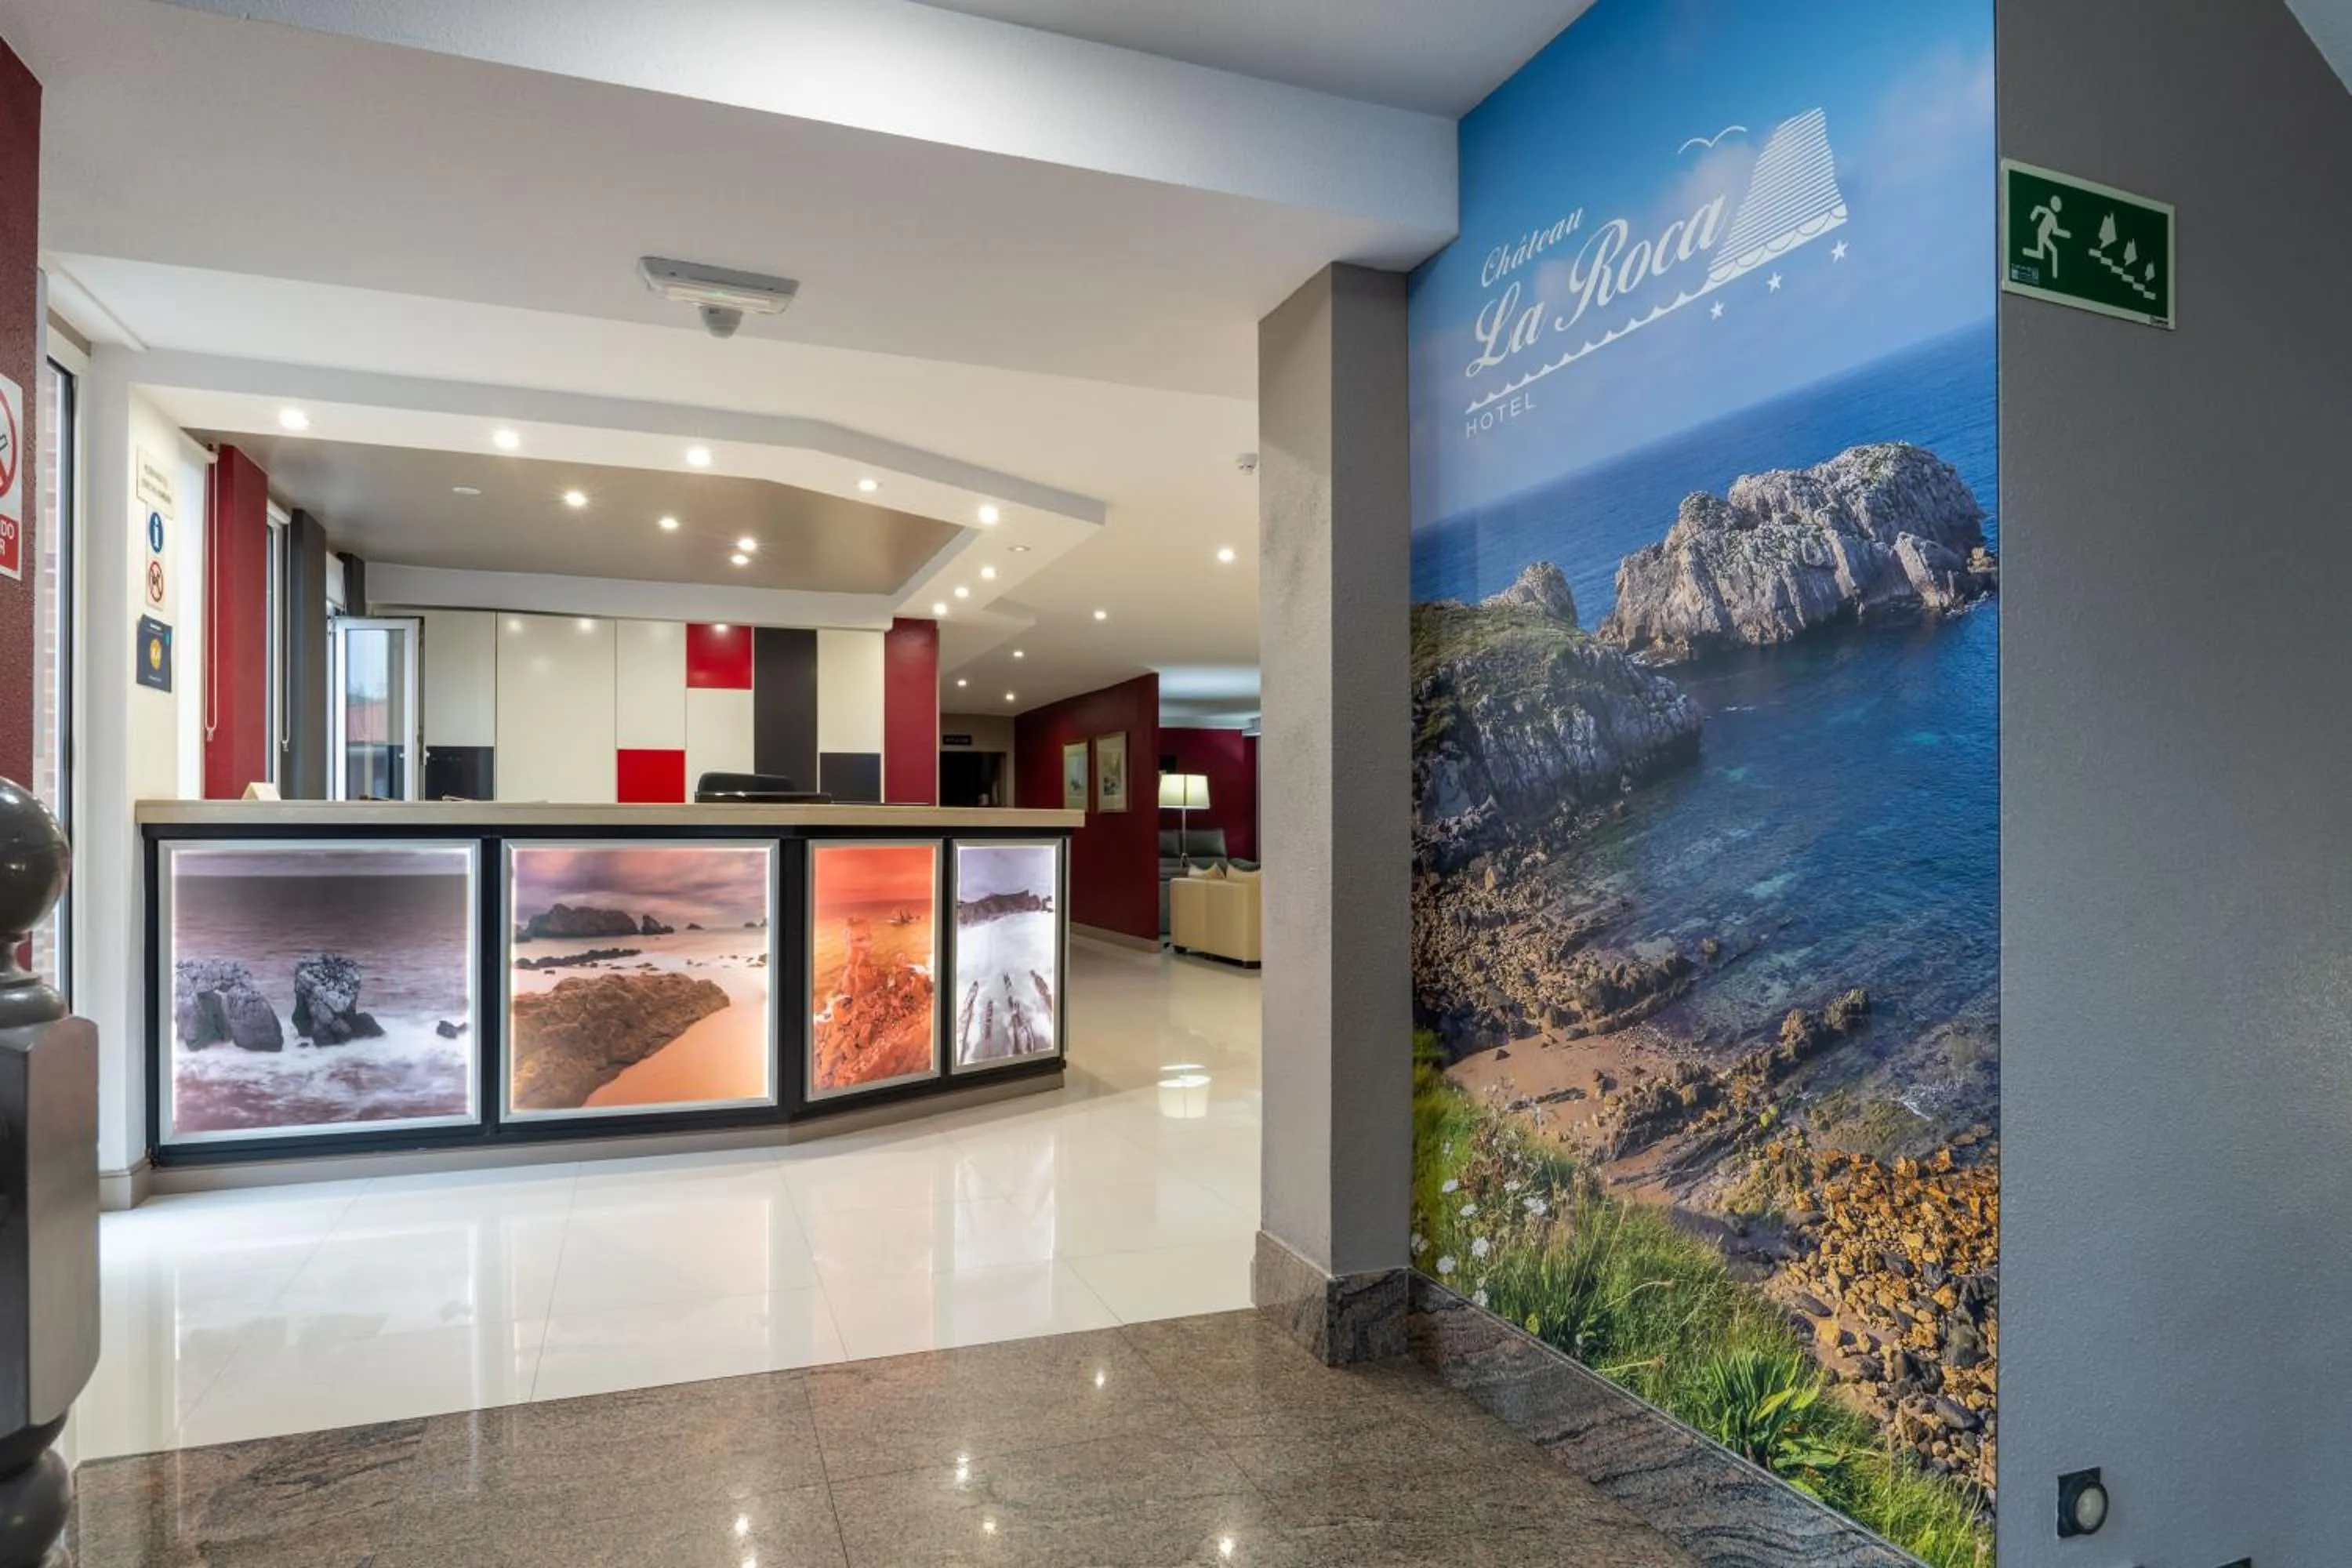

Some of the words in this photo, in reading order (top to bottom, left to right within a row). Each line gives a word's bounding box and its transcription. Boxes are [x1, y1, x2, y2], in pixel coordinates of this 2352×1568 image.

[1465, 281, 1547, 378] La
[1555, 194, 1728, 332] Roca
[1466, 393, 1536, 439] HOTEL
